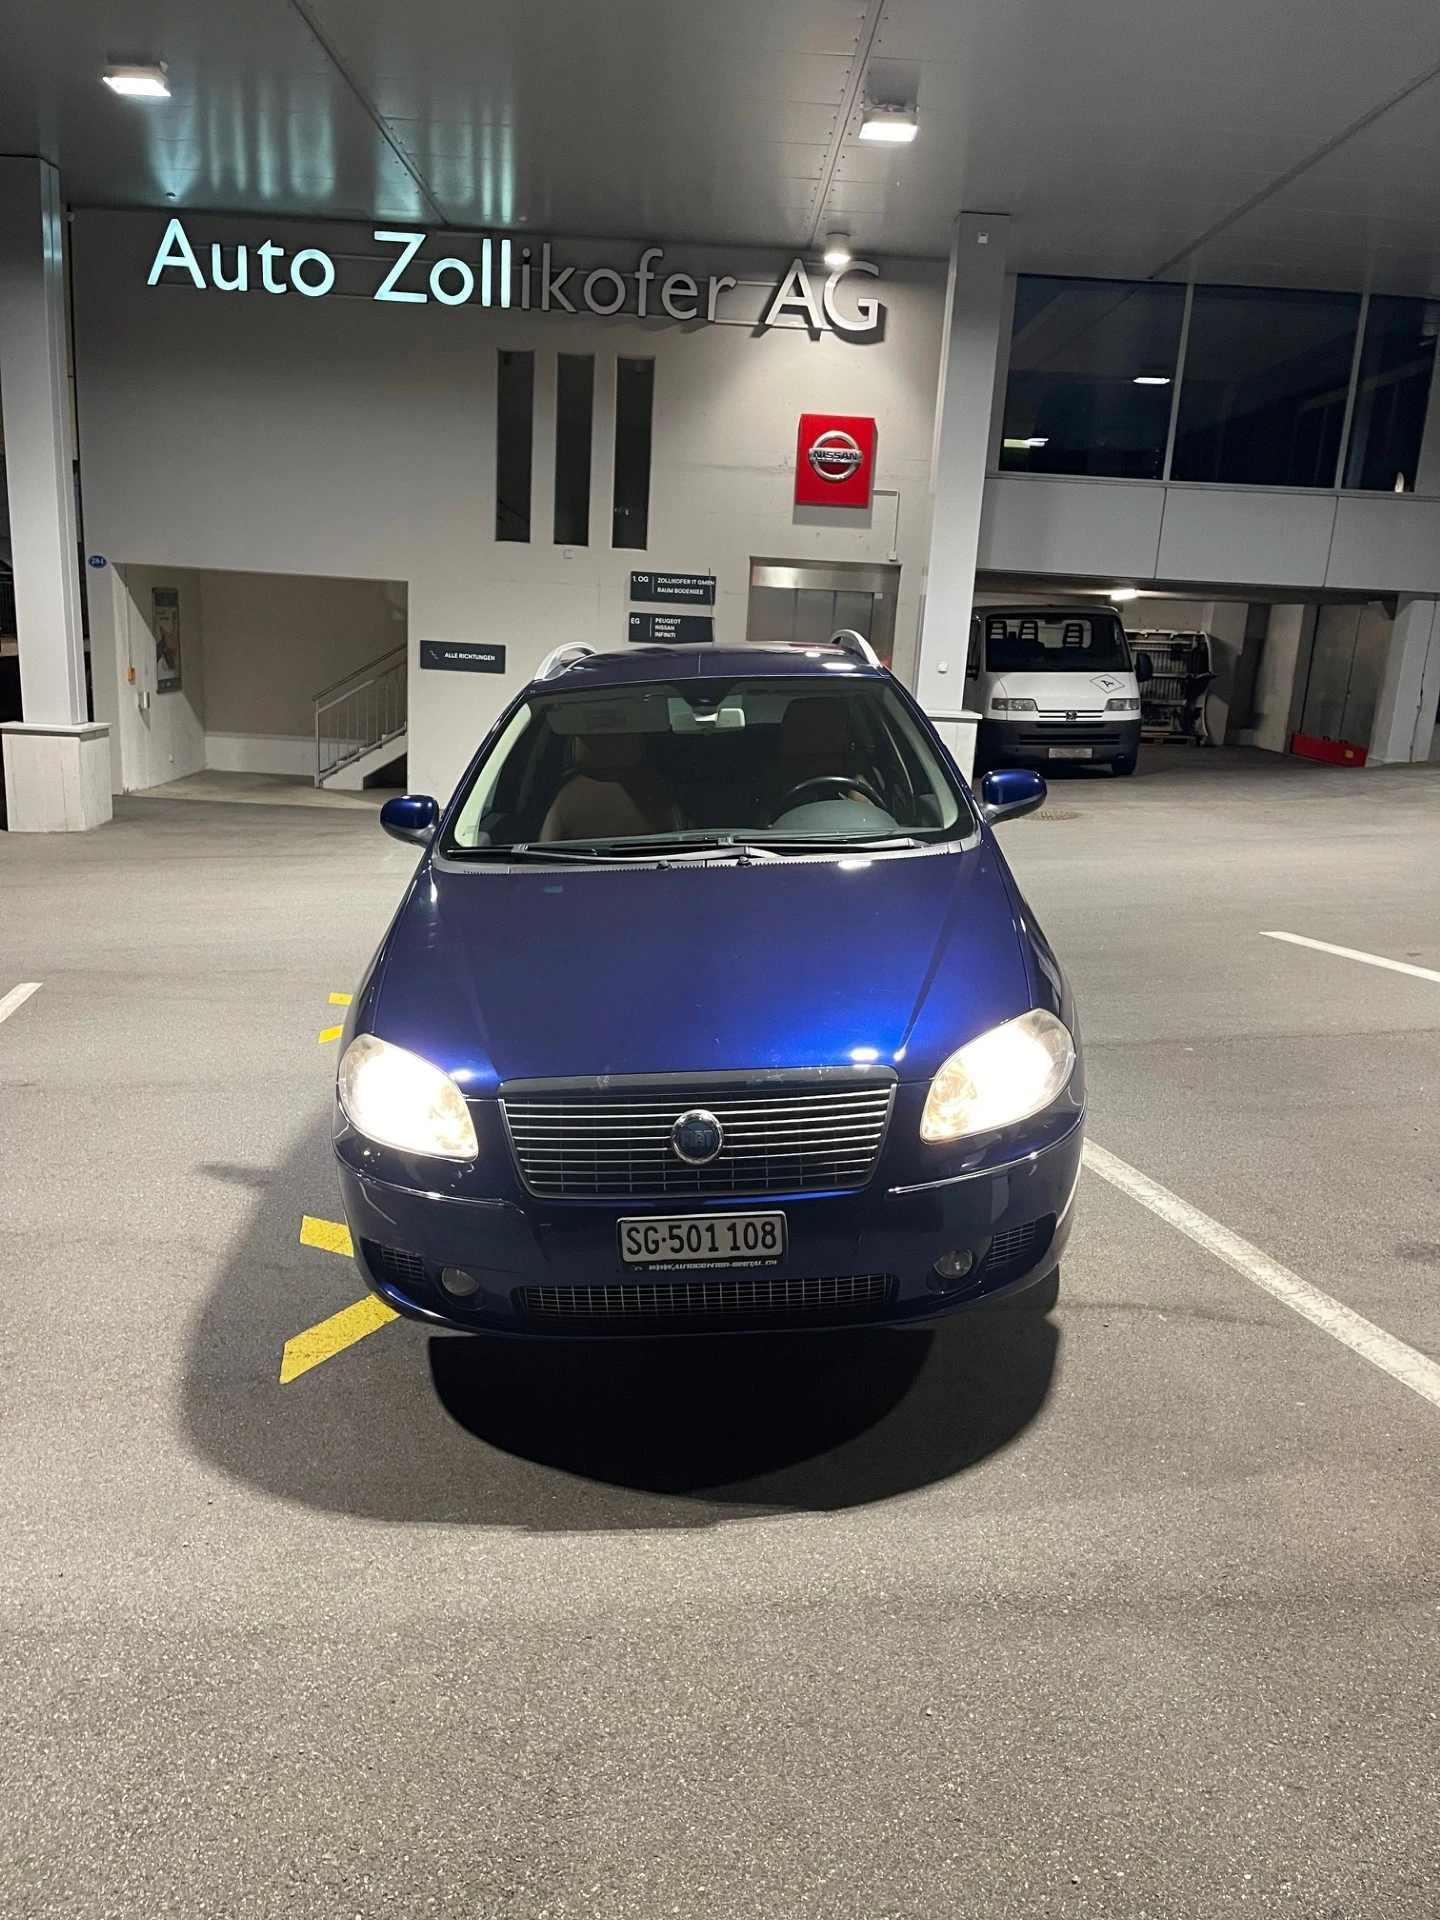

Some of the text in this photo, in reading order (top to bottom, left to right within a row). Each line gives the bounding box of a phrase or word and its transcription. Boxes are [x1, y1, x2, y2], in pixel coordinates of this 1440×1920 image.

[147, 218, 880, 332] Auto Zollikofer AG
[813, 450, 858, 460] NISSAN
[638, 575, 649, 583] OG
[657, 577, 691, 585] ZOLLIKOFER
[674, 588, 704, 596] BODENSEE
[630, 617, 681, 625] EG PEUGEOT
[458, 653, 495, 661] RICHTUNGEN
[680, 1129, 713, 1147] FIAT
